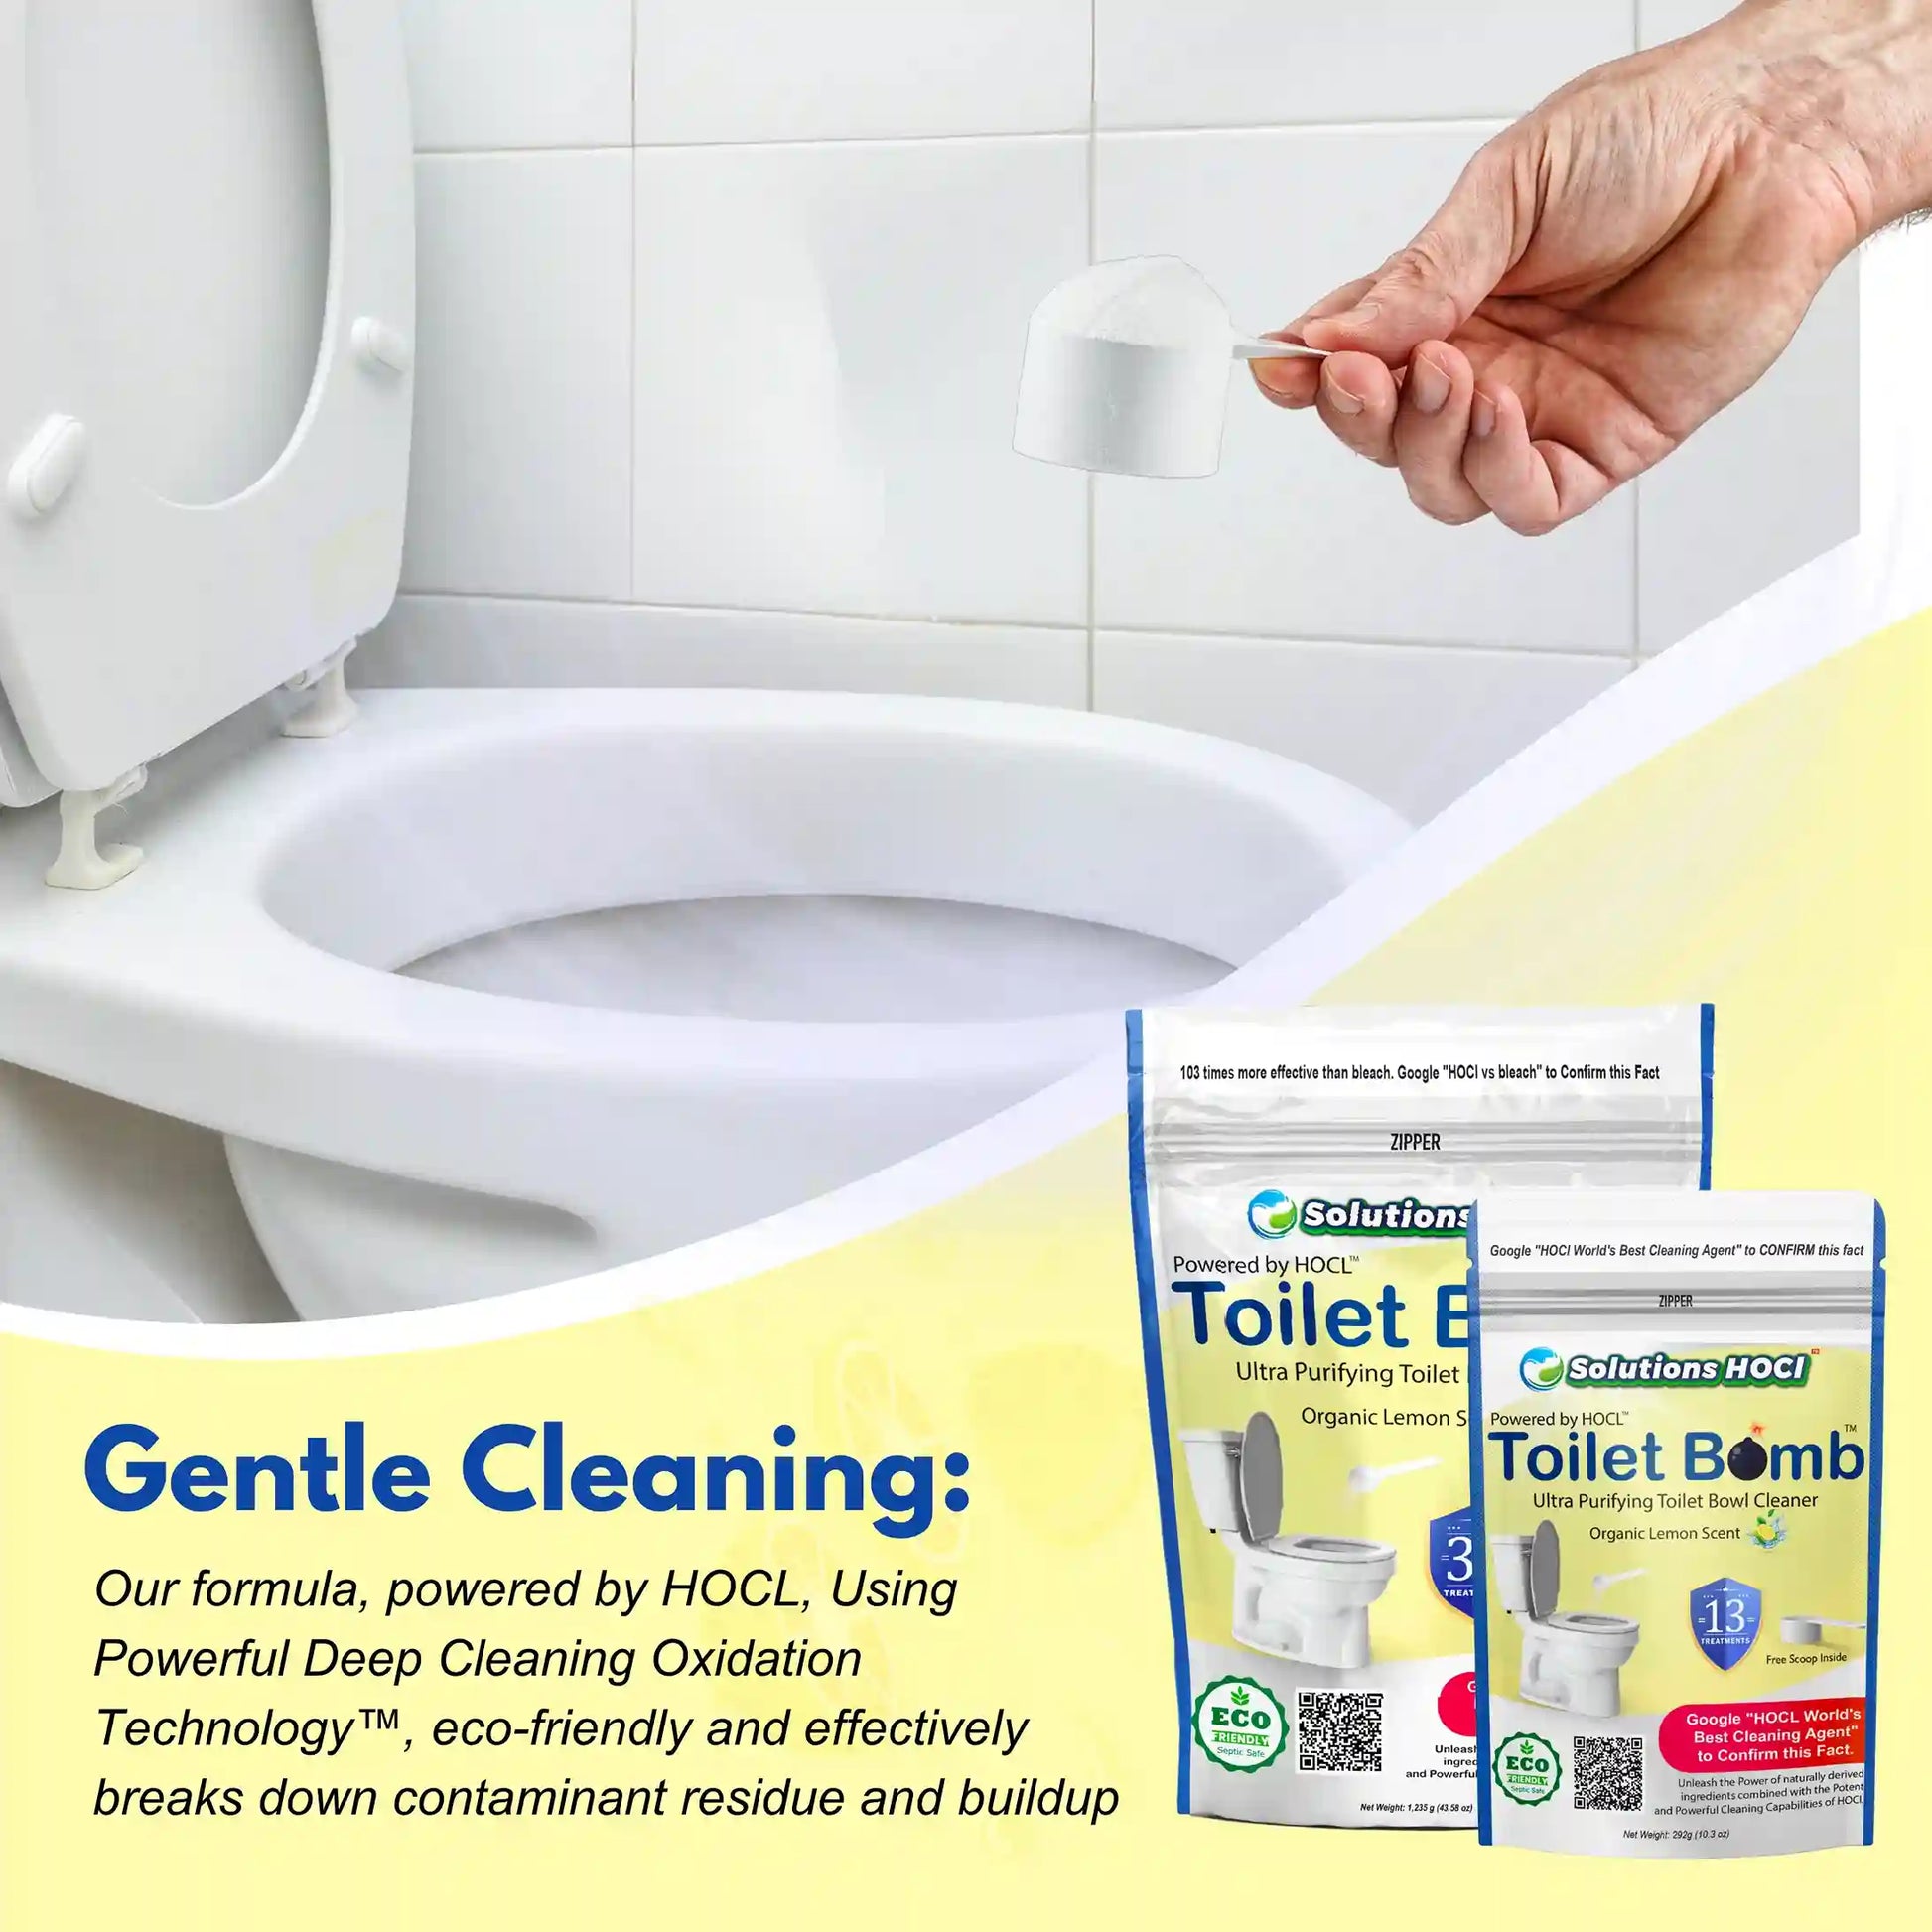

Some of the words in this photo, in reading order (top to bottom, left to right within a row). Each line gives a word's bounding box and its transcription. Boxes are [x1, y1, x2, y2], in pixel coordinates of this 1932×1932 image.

[1180, 1065, 1200, 1080] 103
[1203, 1065, 1234, 1080] times
[1238, 1069, 1267, 1080] more
[1271, 1064, 1319, 1080] effective
[1322, 1064, 1348, 1080] than
[1352, 1064, 1394, 1080] bleach.
[1397, 1064, 1439, 1083] Google
[1481, 1068, 1495, 1079] vs
[1498, 1064, 1542, 1079] bleach"
[1546, 1066, 1557, 1079] to
[1560, 1064, 1606, 1079] Confirm
[1609, 1064, 1631, 1079] this
[1635, 1065, 1660, 1080] Fact
[1390, 1133, 1441, 1152] ZIPPER
[1304, 1199, 1469, 1229] Solutions
[1490, 1245, 1531, 1259] Google
[1574, 1244, 1616, 1256] World's
[1619, 1244, 1646, 1256] Best
[1649, 1244, 1699, 1259] Cleaning
[1702, 1244, 1742, 1258] Agent"
[1744, 1246, 1756, 1256] to
[1759, 1244, 1815, 1256] CONFIRM
[1818, 1244, 1840, 1256] this
[1843, 1244, 1864, 1256] fact
[1173, 1255, 1259, 1274] Powered
[1266, 1256, 1289, 1278] by
[1659, 1295, 1693, 1307] ZIPPER
[1171, 1281, 1409, 1348] Toilet
[1236, 1362, 1288, 1381] Ultra
[1295, 1362, 1394, 1387] Purifying
[1399, 1364, 1460, 1384] Toilet
[1569, 1354, 1718, 1381] Solutions
[1302, 1407, 1378, 1428] Organic
[1384, 1408, 1450, 1426] Lemon
[1490, 1413, 1555, 1427] Powered
[1560, 1413, 1578, 1430] by
[1488, 1431, 1665, 1481] Toilet
[1533, 1494, 1573, 1509] Ultra
[1579, 1493, 1653, 1511] Purifying
[1657, 1493, 1703, 1508] Toilet
[1709, 1493, 1748, 1508] Bowl
[1754, 1492, 1819, 1508] Cleaner
[1589, 1527, 1645, 1544] Organic
[1650, 1527, 1696, 1540] Lemon
[1702, 1526, 1740, 1540] Scent
[1766, 1655, 1787, 1664] Free
[1789, 1654, 1818, 1665] Scoop
[1820, 1652, 1848, 1662] Inside
[1211, 1707, 1271, 1729] ECO
[1686, 1713, 1741, 1727] Google
[1746, 1711, 1799, 1724] "HOCL
[1804, 1708, 1862, 1722] World's
[1213, 1731, 1269, 1746] FRIENDLY
[1694, 1730, 1729, 1743] Best
[1733, 1728, 1801, 1743] Cleaning
[1805, 1725, 1859, 1740] Agent"
[1217, 1747, 1243, 1756] Septic
[1697, 1750, 1713, 1762] to
[1717, 1747, 1778, 1761] Confirm
[1783, 1746, 1812, 1759] this
[1816, 1744, 1854, 1757] Fact.
[1506, 1756, 1549, 1772] ECO
[1406, 1769, 1427, 1778] and
[1507, 1774, 1548, 1786] FRIENDLY
[1678, 1777, 1717, 1788] Unleash
[1720, 1777, 1735, 1787] the
[1738, 1775, 1768, 1786] Power
[1770, 1775, 1781, 1785] of
[1783, 1772, 1826, 1783] naturally
[1828, 1769, 1864, 1780] derived
[1681, 1790, 1735, 1802] ingredients
[1737, 1788, 1787, 1799] combined
[1790, 1786, 1812, 1797] with
[1814, 1785, 1831, 1794] the
[1833, 1784, 1863, 1793] Potent
[1376, 1804, 1405, 1813] Weight:
[1437, 1803, 1459, 1813] (43.58
[1461, 1804, 1473, 1813] oz)
[1654, 1806, 1673, 1816] and
[1675, 1805, 1719, 1816] Powerful
[1721, 1803, 1763, 1815] Cleaning
[1765, 1800, 1823, 1813] Capabilities
[1825, 1797, 1836, 1807] of
[1623, 1830, 1638, 1839] Net
[1640, 1830, 1670, 1841] Weight:
[1673, 1830, 1693, 1841] 292g
[1695, 1830, 1716, 1840] (10.3
[1718, 1830, 1729, 1839] oz)
